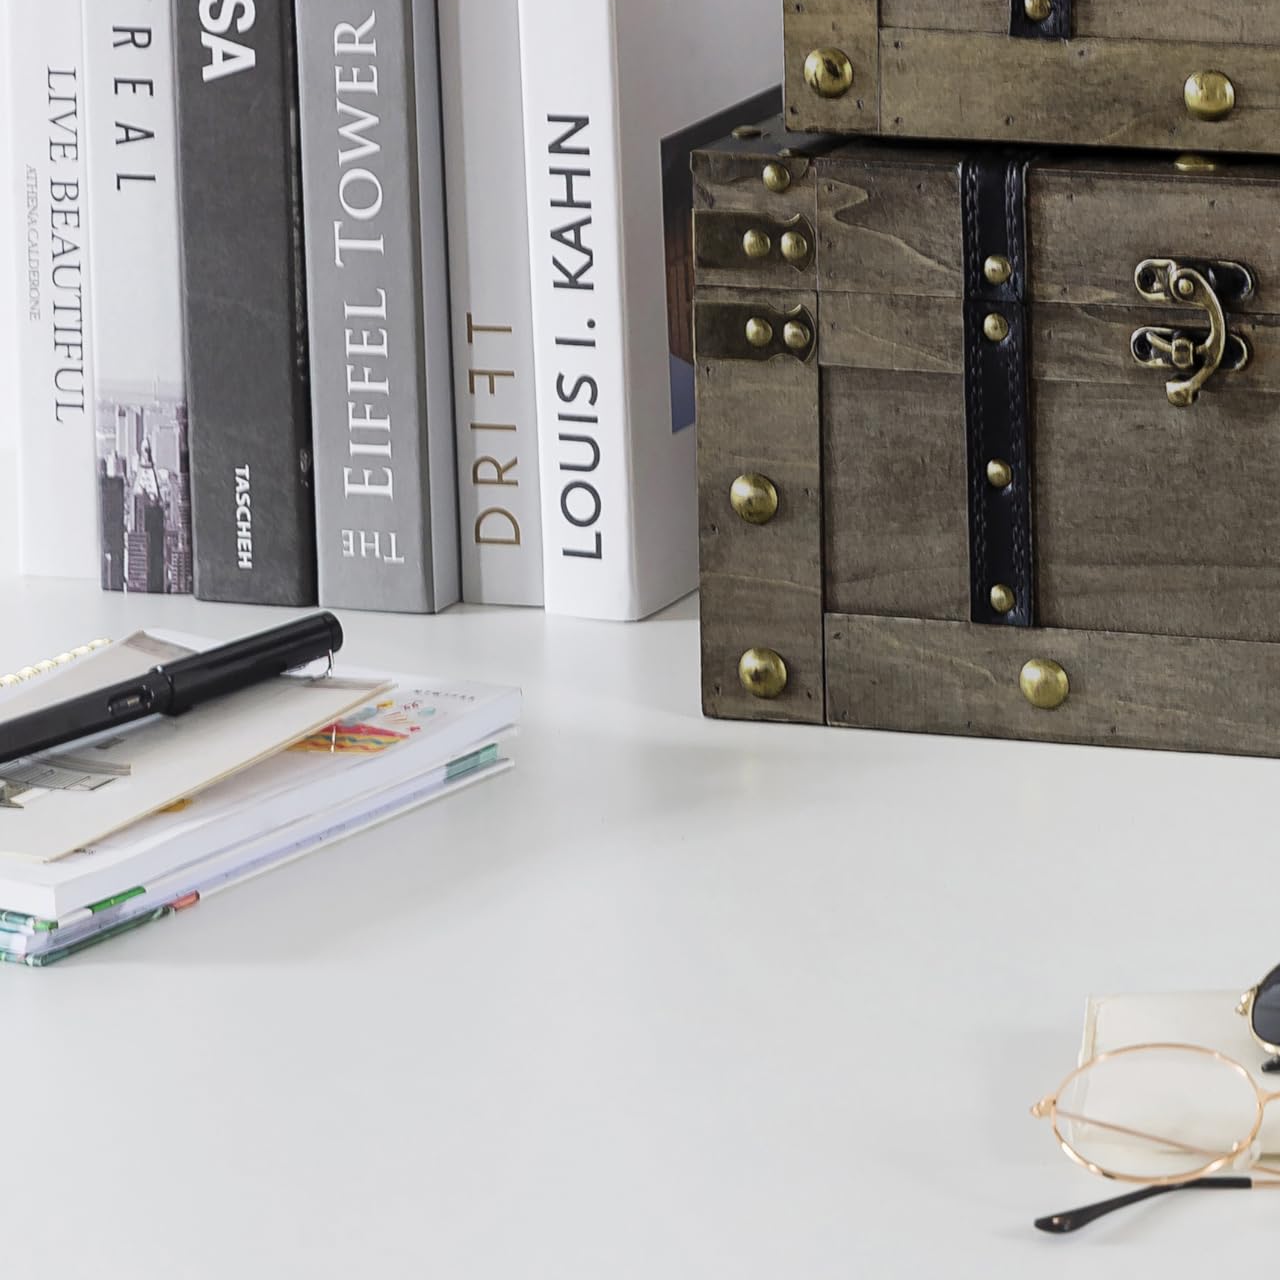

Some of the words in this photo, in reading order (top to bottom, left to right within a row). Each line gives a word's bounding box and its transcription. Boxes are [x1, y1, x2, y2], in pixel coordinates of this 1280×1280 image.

[26, 163, 39, 225] ATHENA
[47, 64, 79, 162] LIVE
[333, 9, 384, 268] TOWER
[546, 113, 595, 291] KAHN
[27, 227, 41, 321] CALDERONE
[49, 176, 85, 424] BEAUTIFUL
[554, 317, 597, 348] I.
[343, 287, 394, 502] EIFFEL
[466, 312, 521, 546] DRIFT
[556, 372, 603, 560] LOUIS
[341, 528, 405, 564] THE
